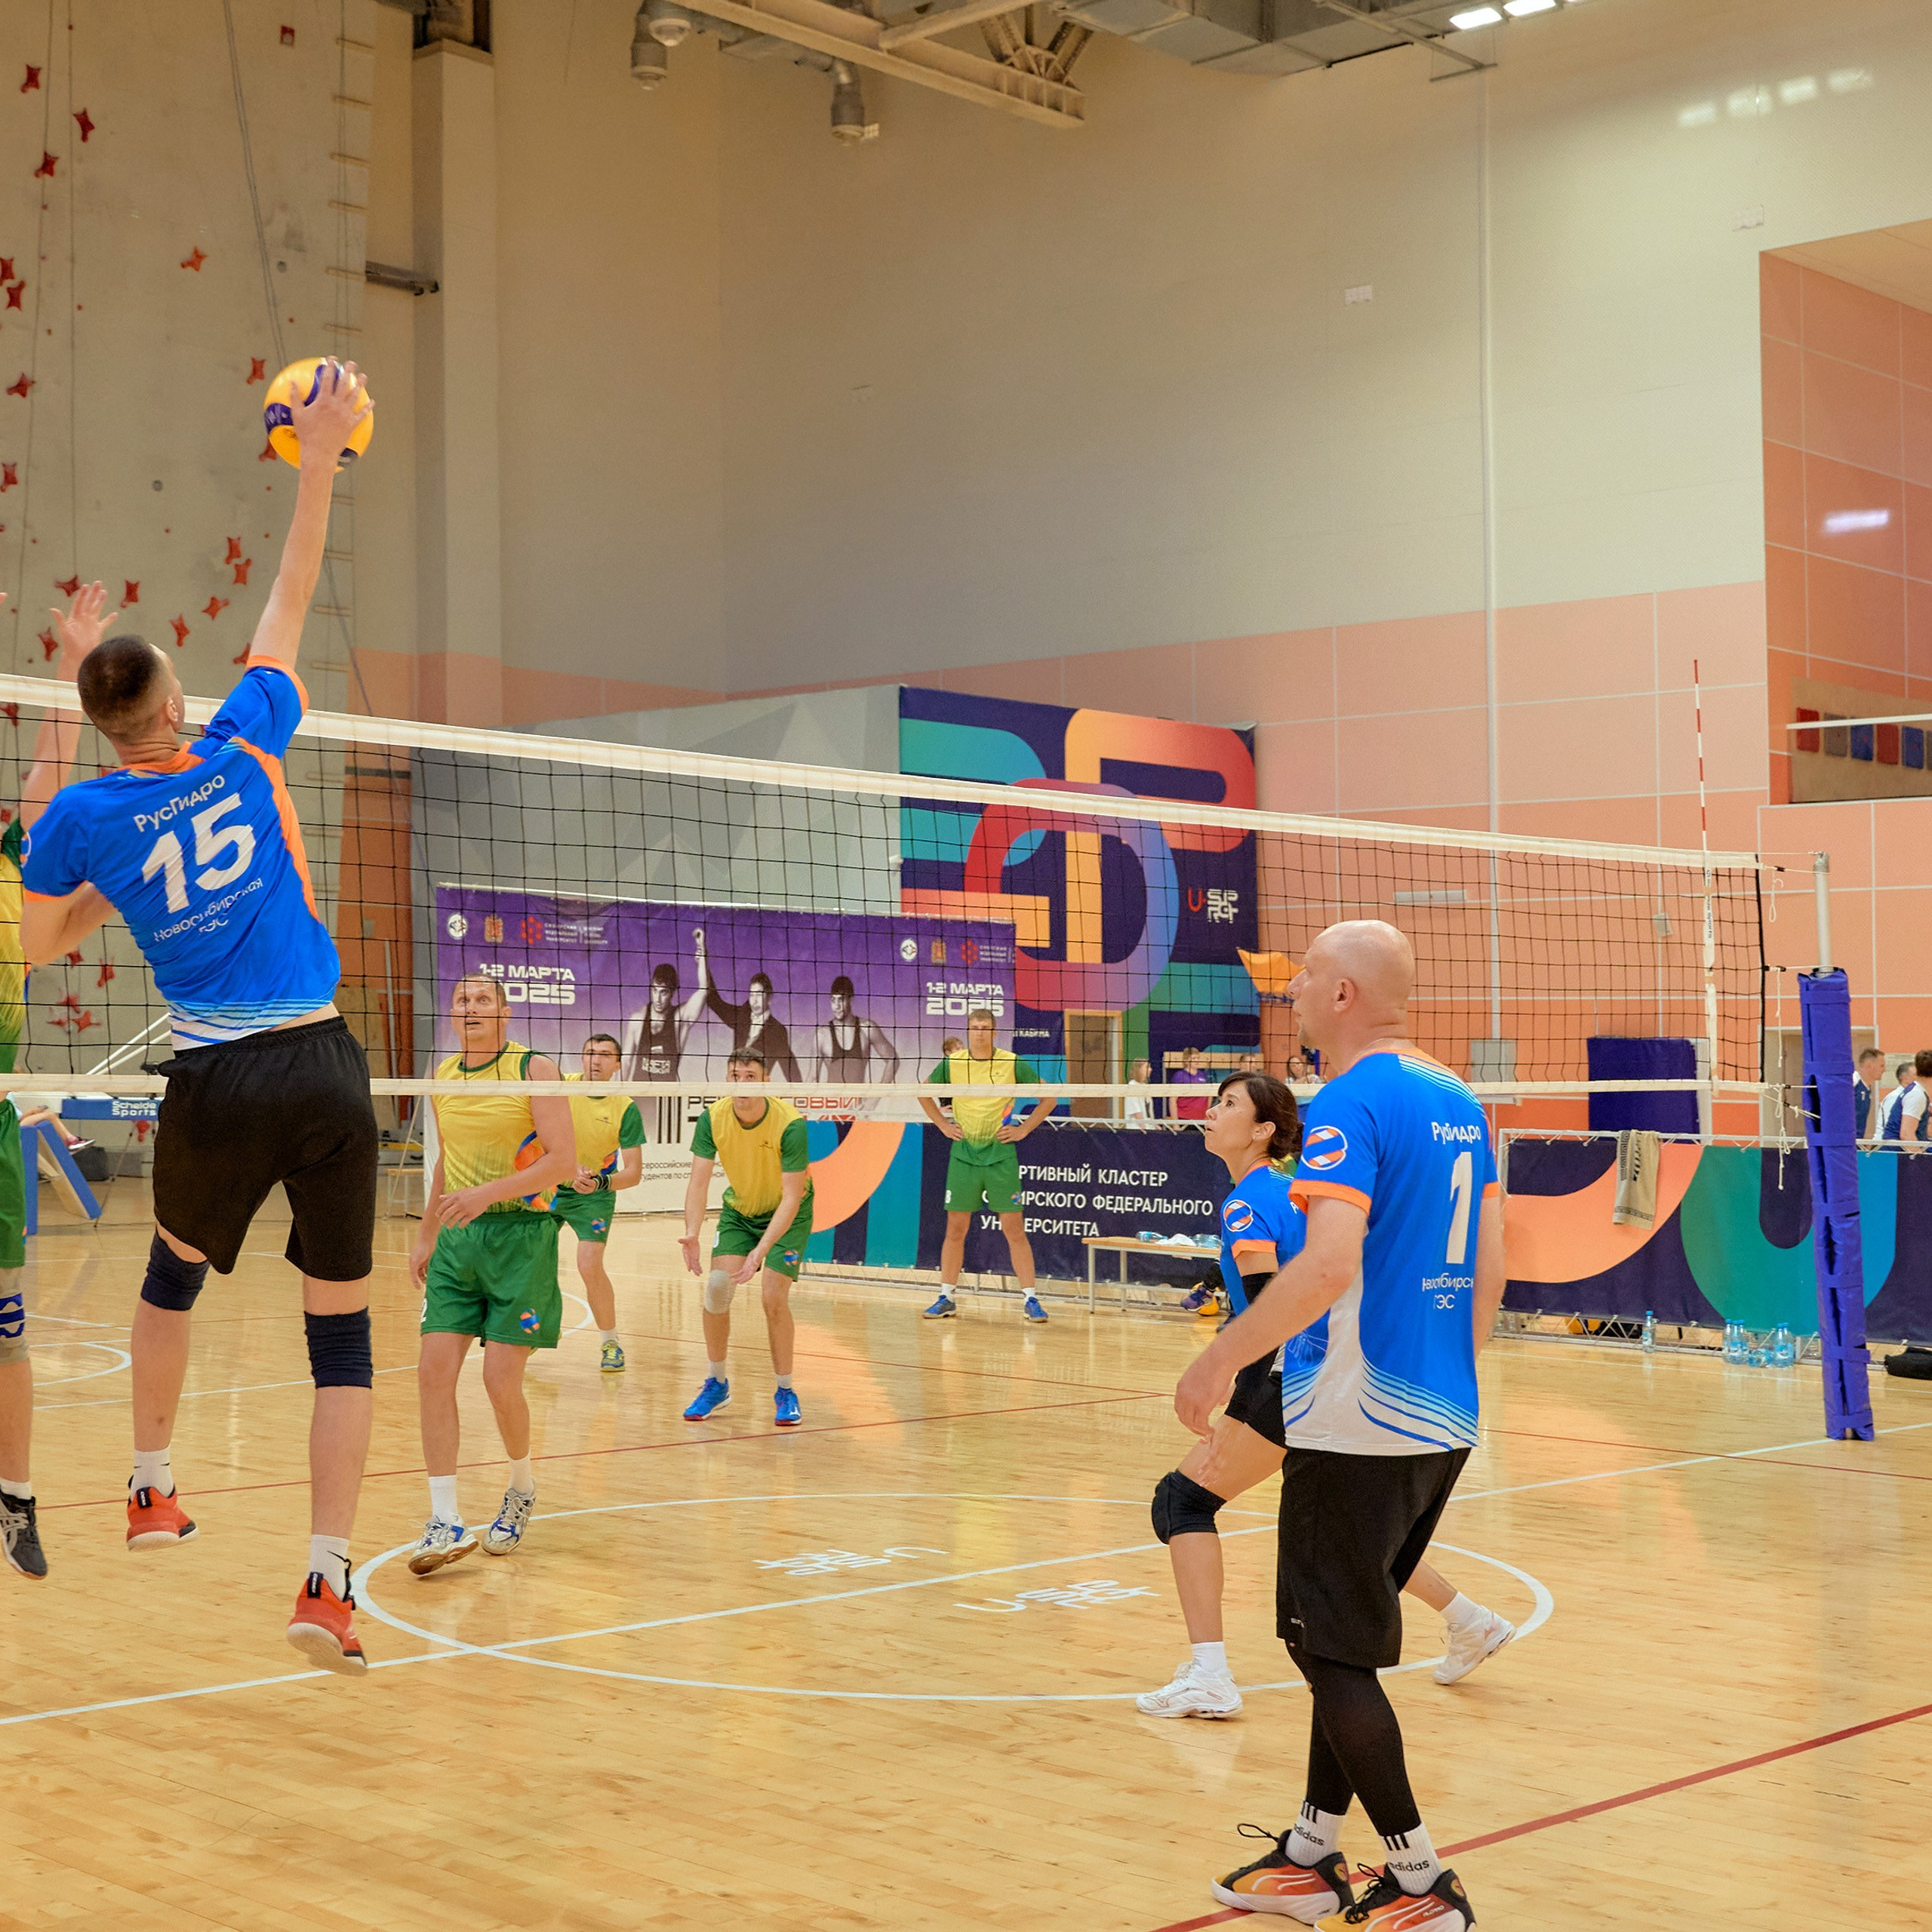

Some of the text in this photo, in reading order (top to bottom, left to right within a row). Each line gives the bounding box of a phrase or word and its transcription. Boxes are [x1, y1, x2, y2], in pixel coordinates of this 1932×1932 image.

[133, 774, 226, 833] РусГидро
[141, 792, 257, 914] 15
[479, 963, 576, 982] 1-2 МАРТА
[499, 980, 576, 1005] 025
[926, 982, 1004, 996] 1-2 МАРТА
[926, 996, 1004, 1017] 2025
[112, 1109, 157, 1118] Sports
[1018, 1163, 1168, 1187] РТИВНЫЙ КЛАСТЕР
[1091, 1194, 1214, 1217] ФЕДЕРАЛЬНОГО
[1445, 1152, 1472, 1264] 1
[980, 1215, 1100, 1237] УНЕРСИТЕТА
